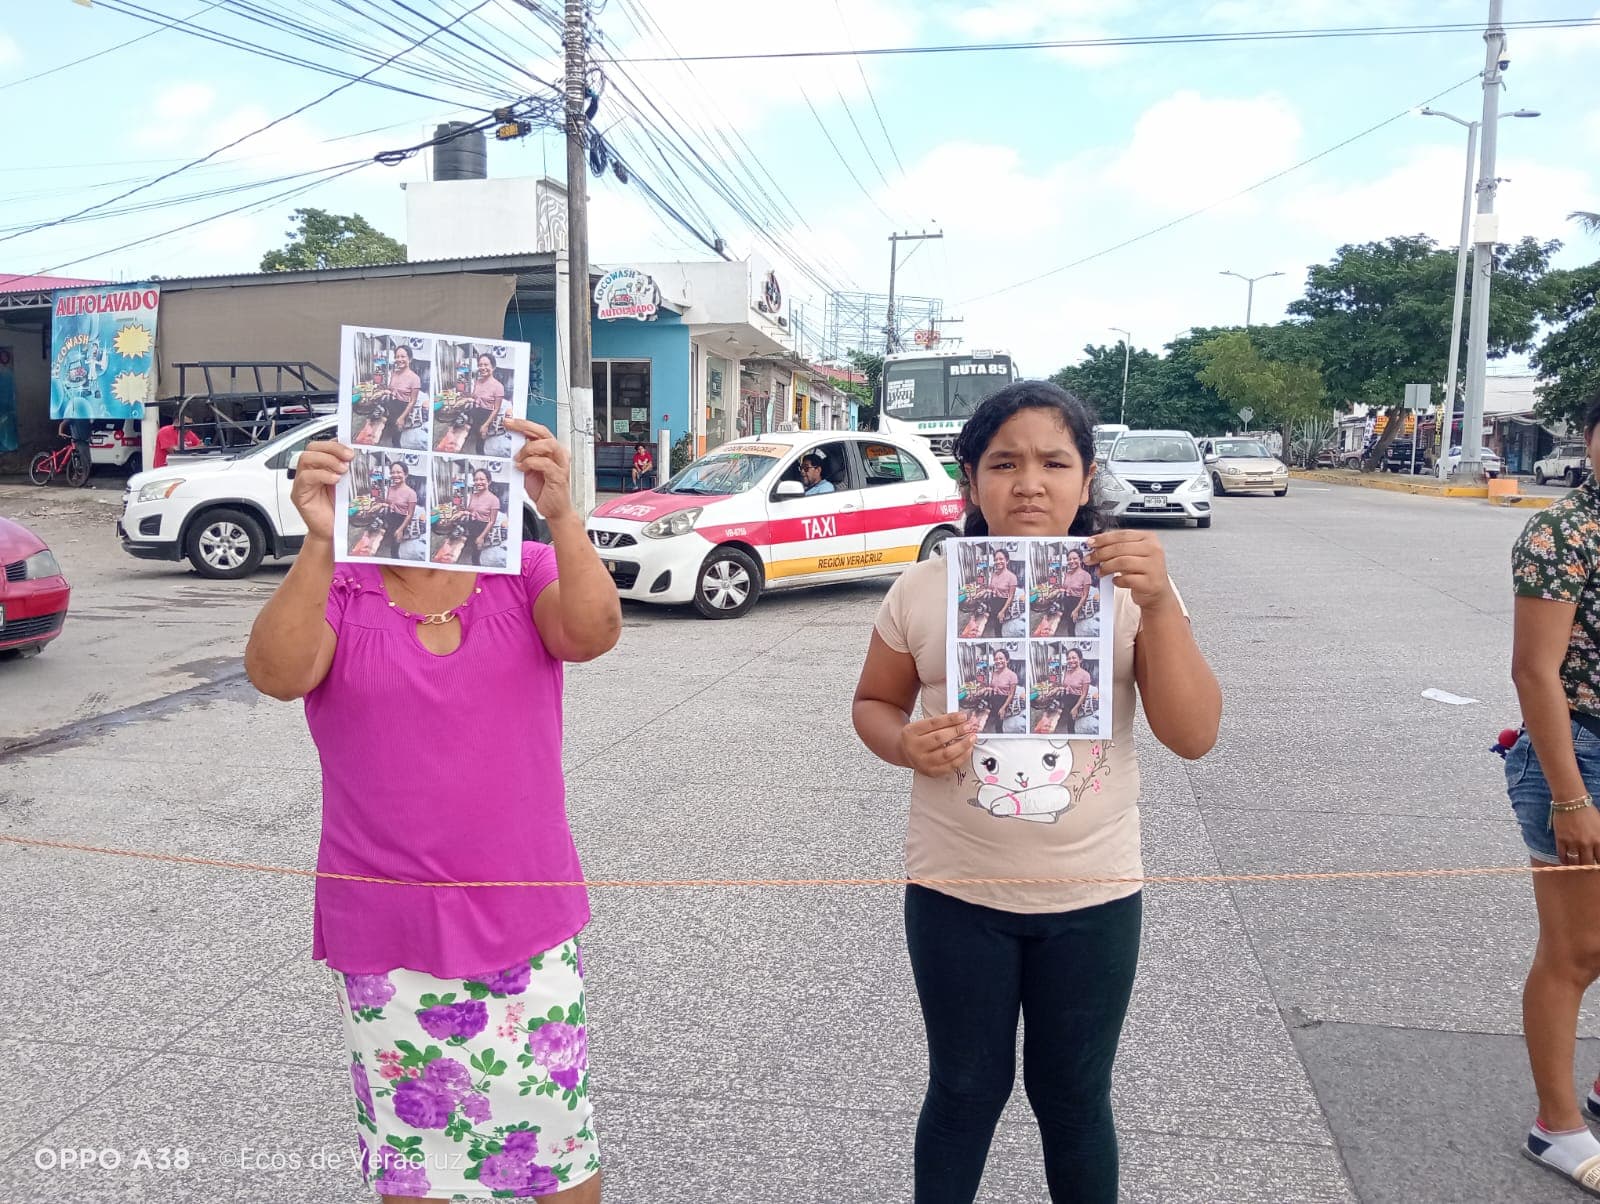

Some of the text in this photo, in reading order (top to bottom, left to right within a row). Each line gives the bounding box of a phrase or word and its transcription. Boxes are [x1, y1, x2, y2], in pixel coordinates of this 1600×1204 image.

[595, 269, 636, 301] LOCOWASH
[56, 290, 158, 317] AUTOLAVADO
[600, 303, 654, 318] AUTOLAVADO
[950, 363, 1008, 376] RUTA 85
[801, 515, 837, 540] TAXI
[846, 552, 883, 566] VERACRUZ
